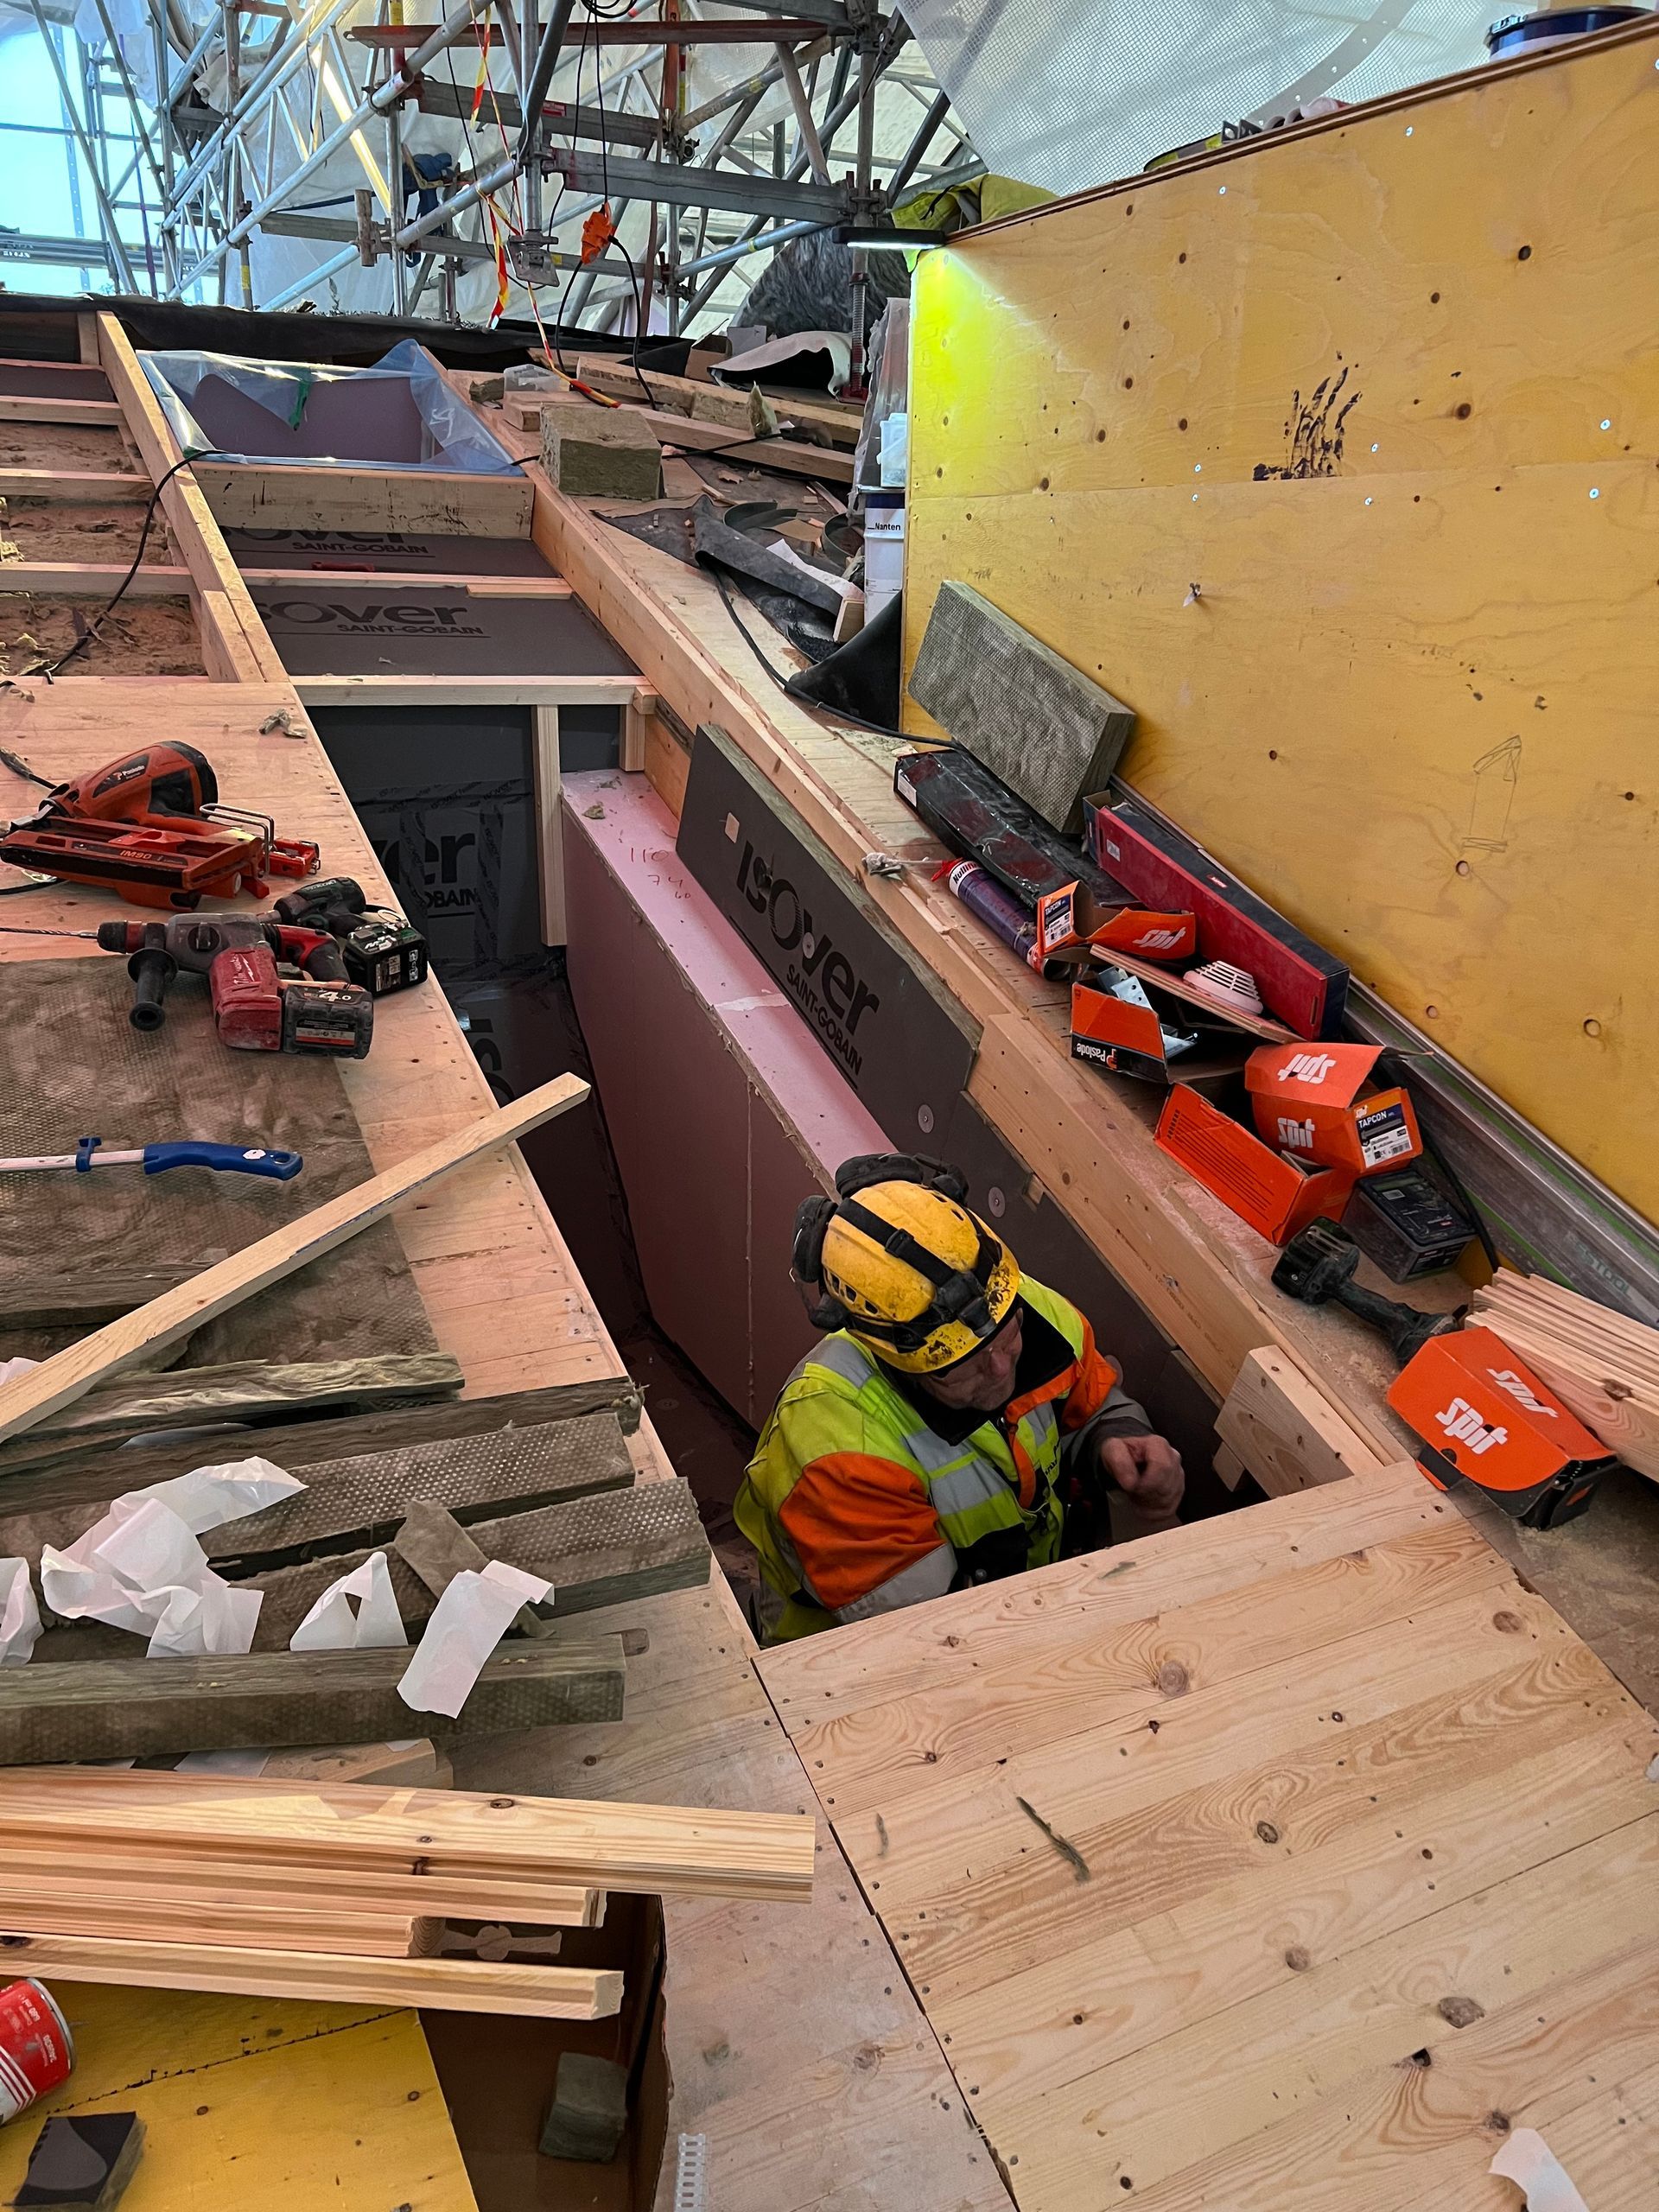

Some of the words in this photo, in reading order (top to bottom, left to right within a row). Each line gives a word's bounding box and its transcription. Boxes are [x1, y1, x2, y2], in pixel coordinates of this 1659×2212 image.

[874, 522, 901, 531] Nanten
[292, 542, 429, 554] SAINT-GOBAIN
[337, 624, 483, 635] SAINT-GOBAIN
[120, 849, 152, 860] IM90
[319, 991, 352, 1002] 4.0
[786, 963, 862, 1076] SAINT-GOBAIN
[1076, 1042, 1106, 1063] Paslode
[1277, 1053, 1337, 1084] spit
[1357, 1110, 1388, 1128] TAPCON
[1277, 1117, 1315, 1149] spit
[1486, 1368, 1559, 1419] spit
[1434, 1396, 1509, 1455] spit
